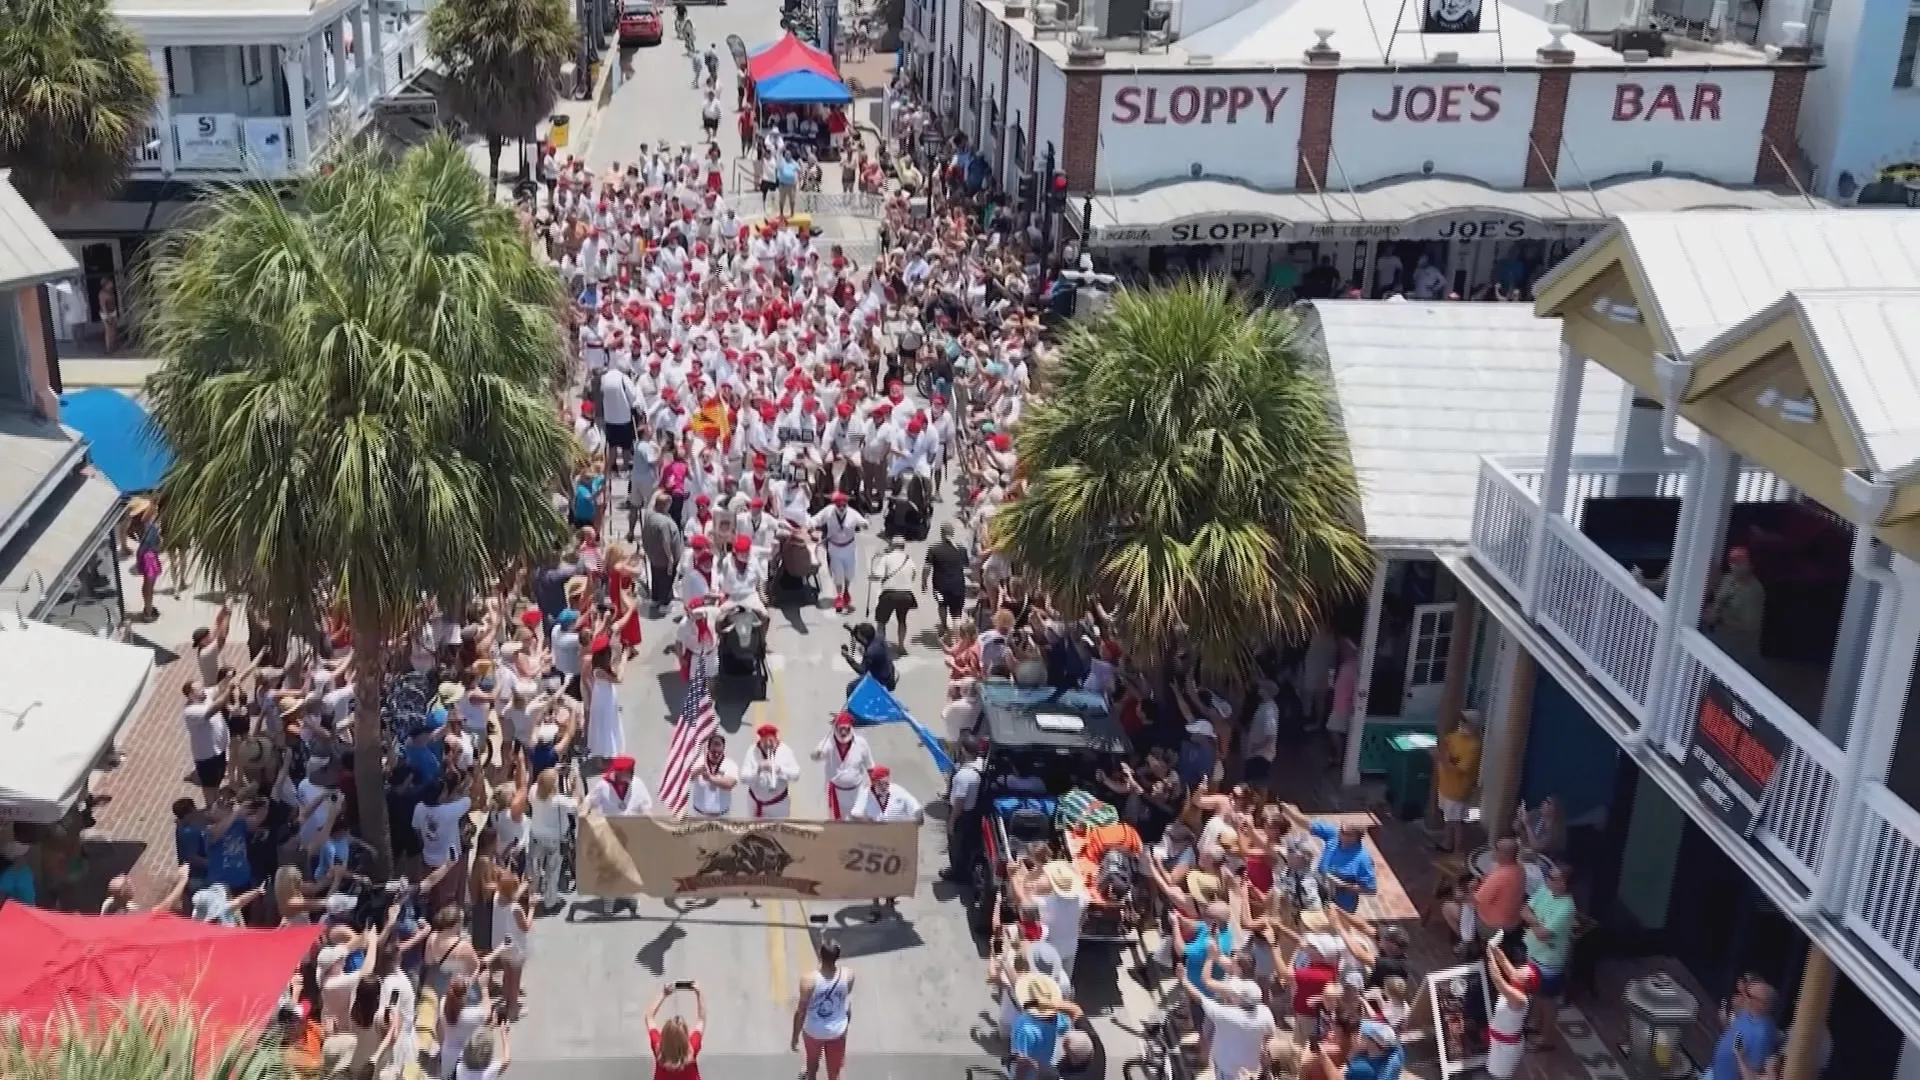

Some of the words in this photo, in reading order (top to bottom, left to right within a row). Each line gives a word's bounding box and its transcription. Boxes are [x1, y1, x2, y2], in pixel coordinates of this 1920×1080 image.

[1112, 85, 1289, 124] SLOPPY
[1371, 83, 1501, 123] JOE'S
[1612, 83, 1721, 121] BAR
[1171, 223, 1285, 241] SLOPPY
[1438, 220, 1526, 238] JOE'S
[844, 848, 901, 876] 250
